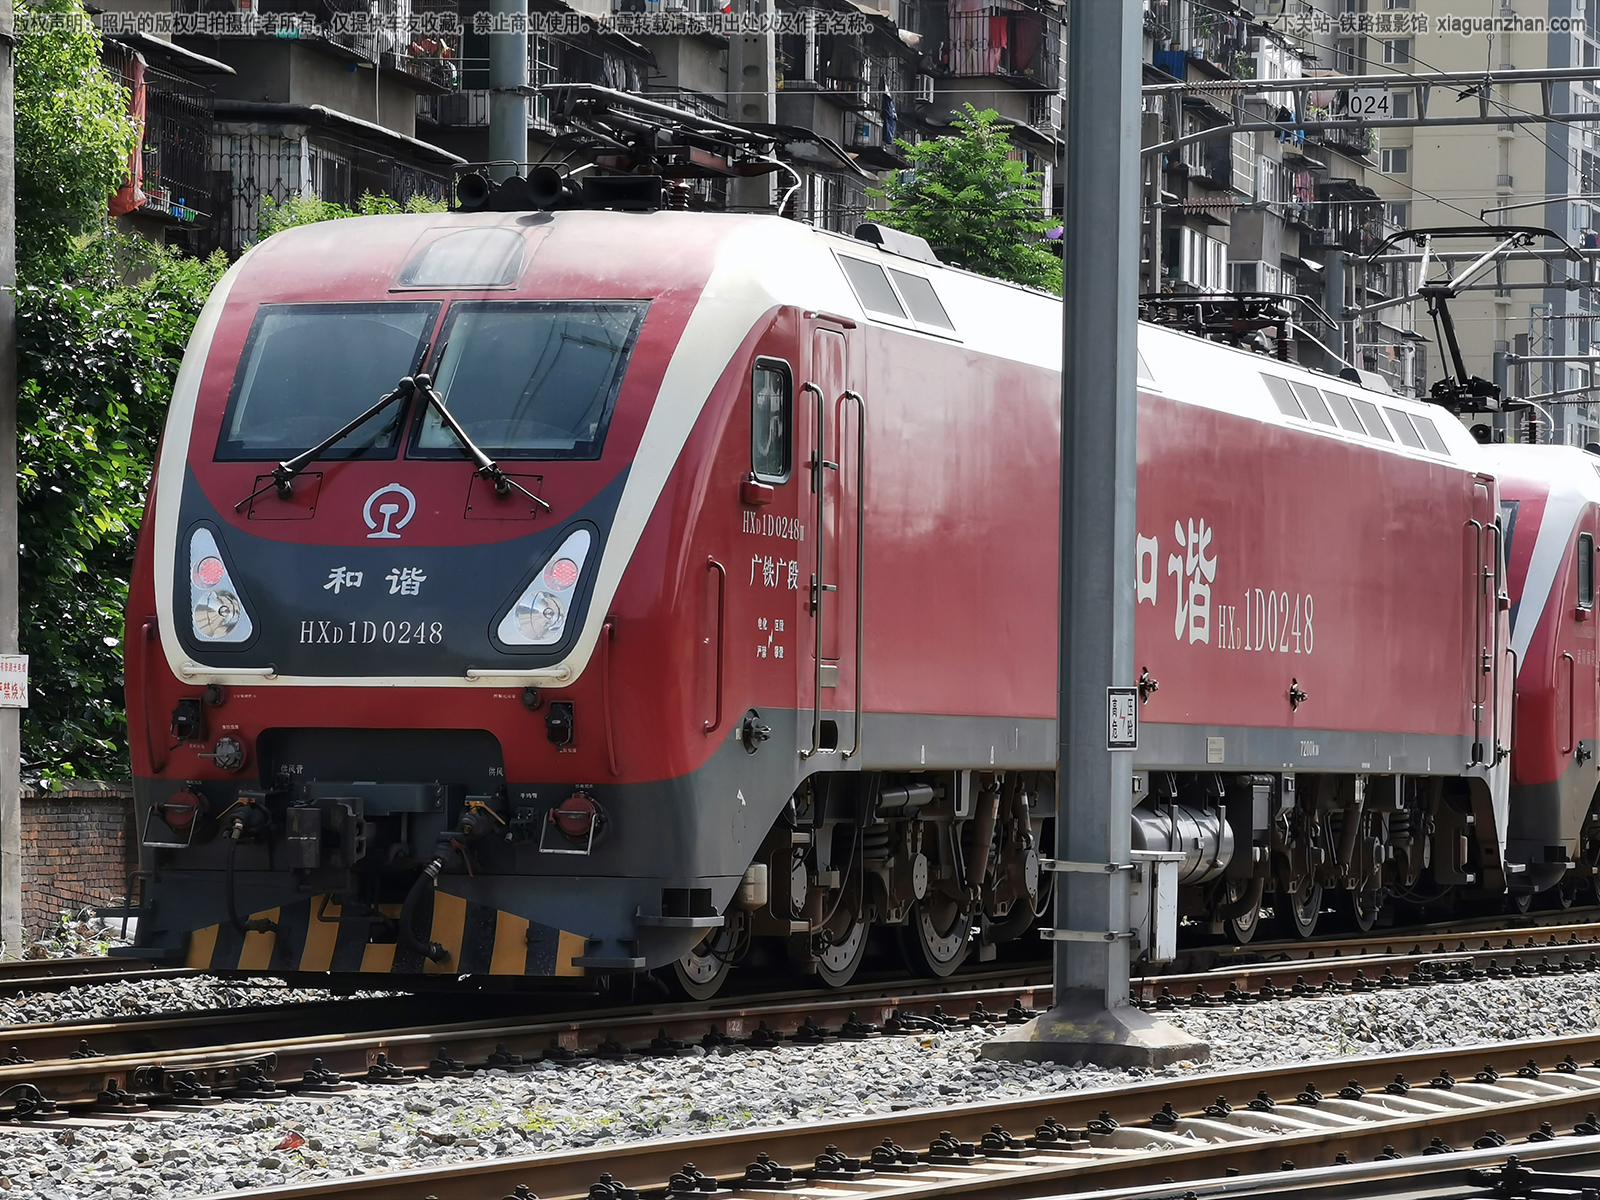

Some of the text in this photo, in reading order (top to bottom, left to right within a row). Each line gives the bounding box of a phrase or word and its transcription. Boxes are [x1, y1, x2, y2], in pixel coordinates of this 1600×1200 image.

[1350, 95, 1390, 115] 024
[322, 566, 427, 596] 和谐
[750, 554, 799, 590] 广铁广段
[300, 620, 443, 645] HXD1D0248
[1218, 588, 1314, 655] HXD1D0248
